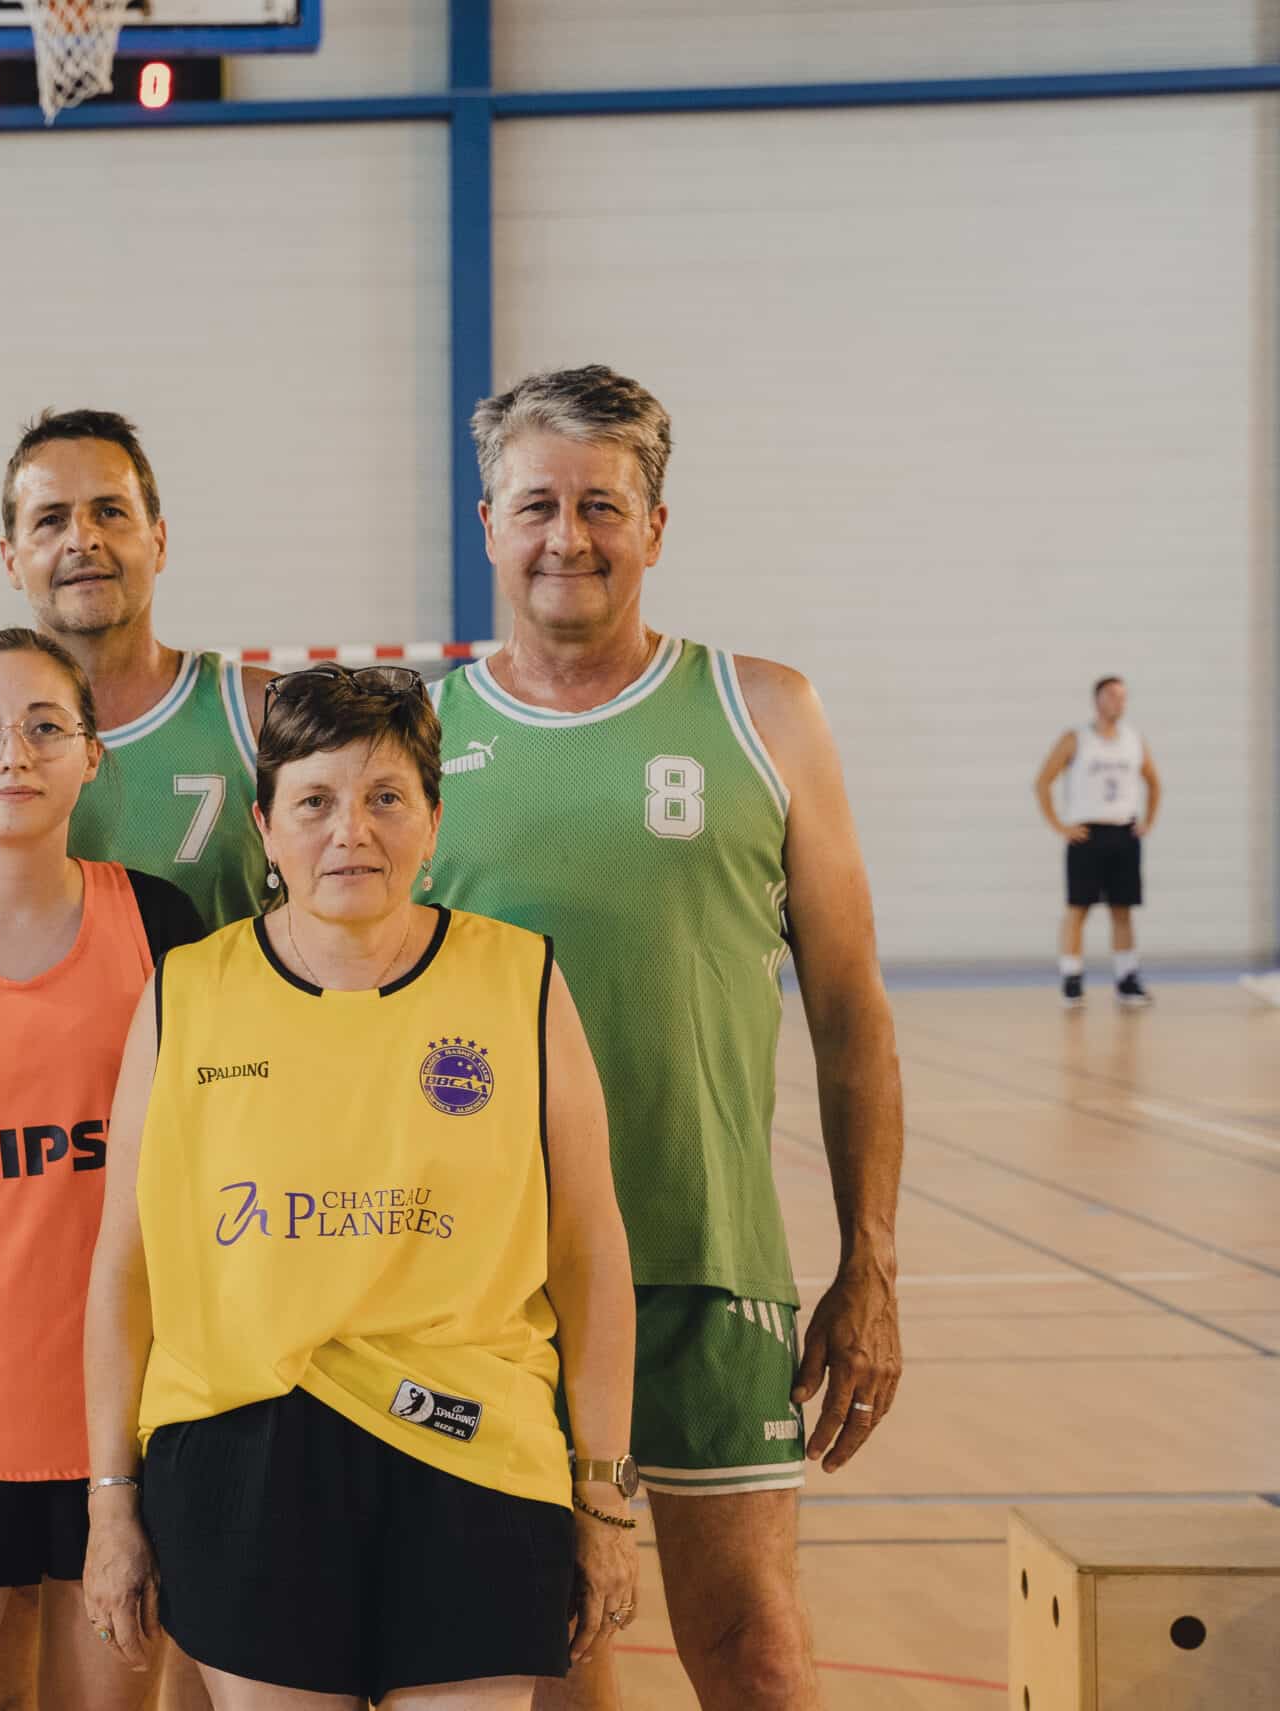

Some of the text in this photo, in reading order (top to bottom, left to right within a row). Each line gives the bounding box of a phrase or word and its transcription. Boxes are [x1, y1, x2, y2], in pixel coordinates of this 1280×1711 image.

[139, 61, 172, 108] 0
[645, 754, 705, 840] 8
[173, 774, 226, 863] 7
[197, 1060, 269, 1085] SPALDING
[322, 1187, 432, 1210] CHATEAU
[433, 1407, 477, 1427] SPALDING
[433, 1421, 466, 1438] SIZE XL
